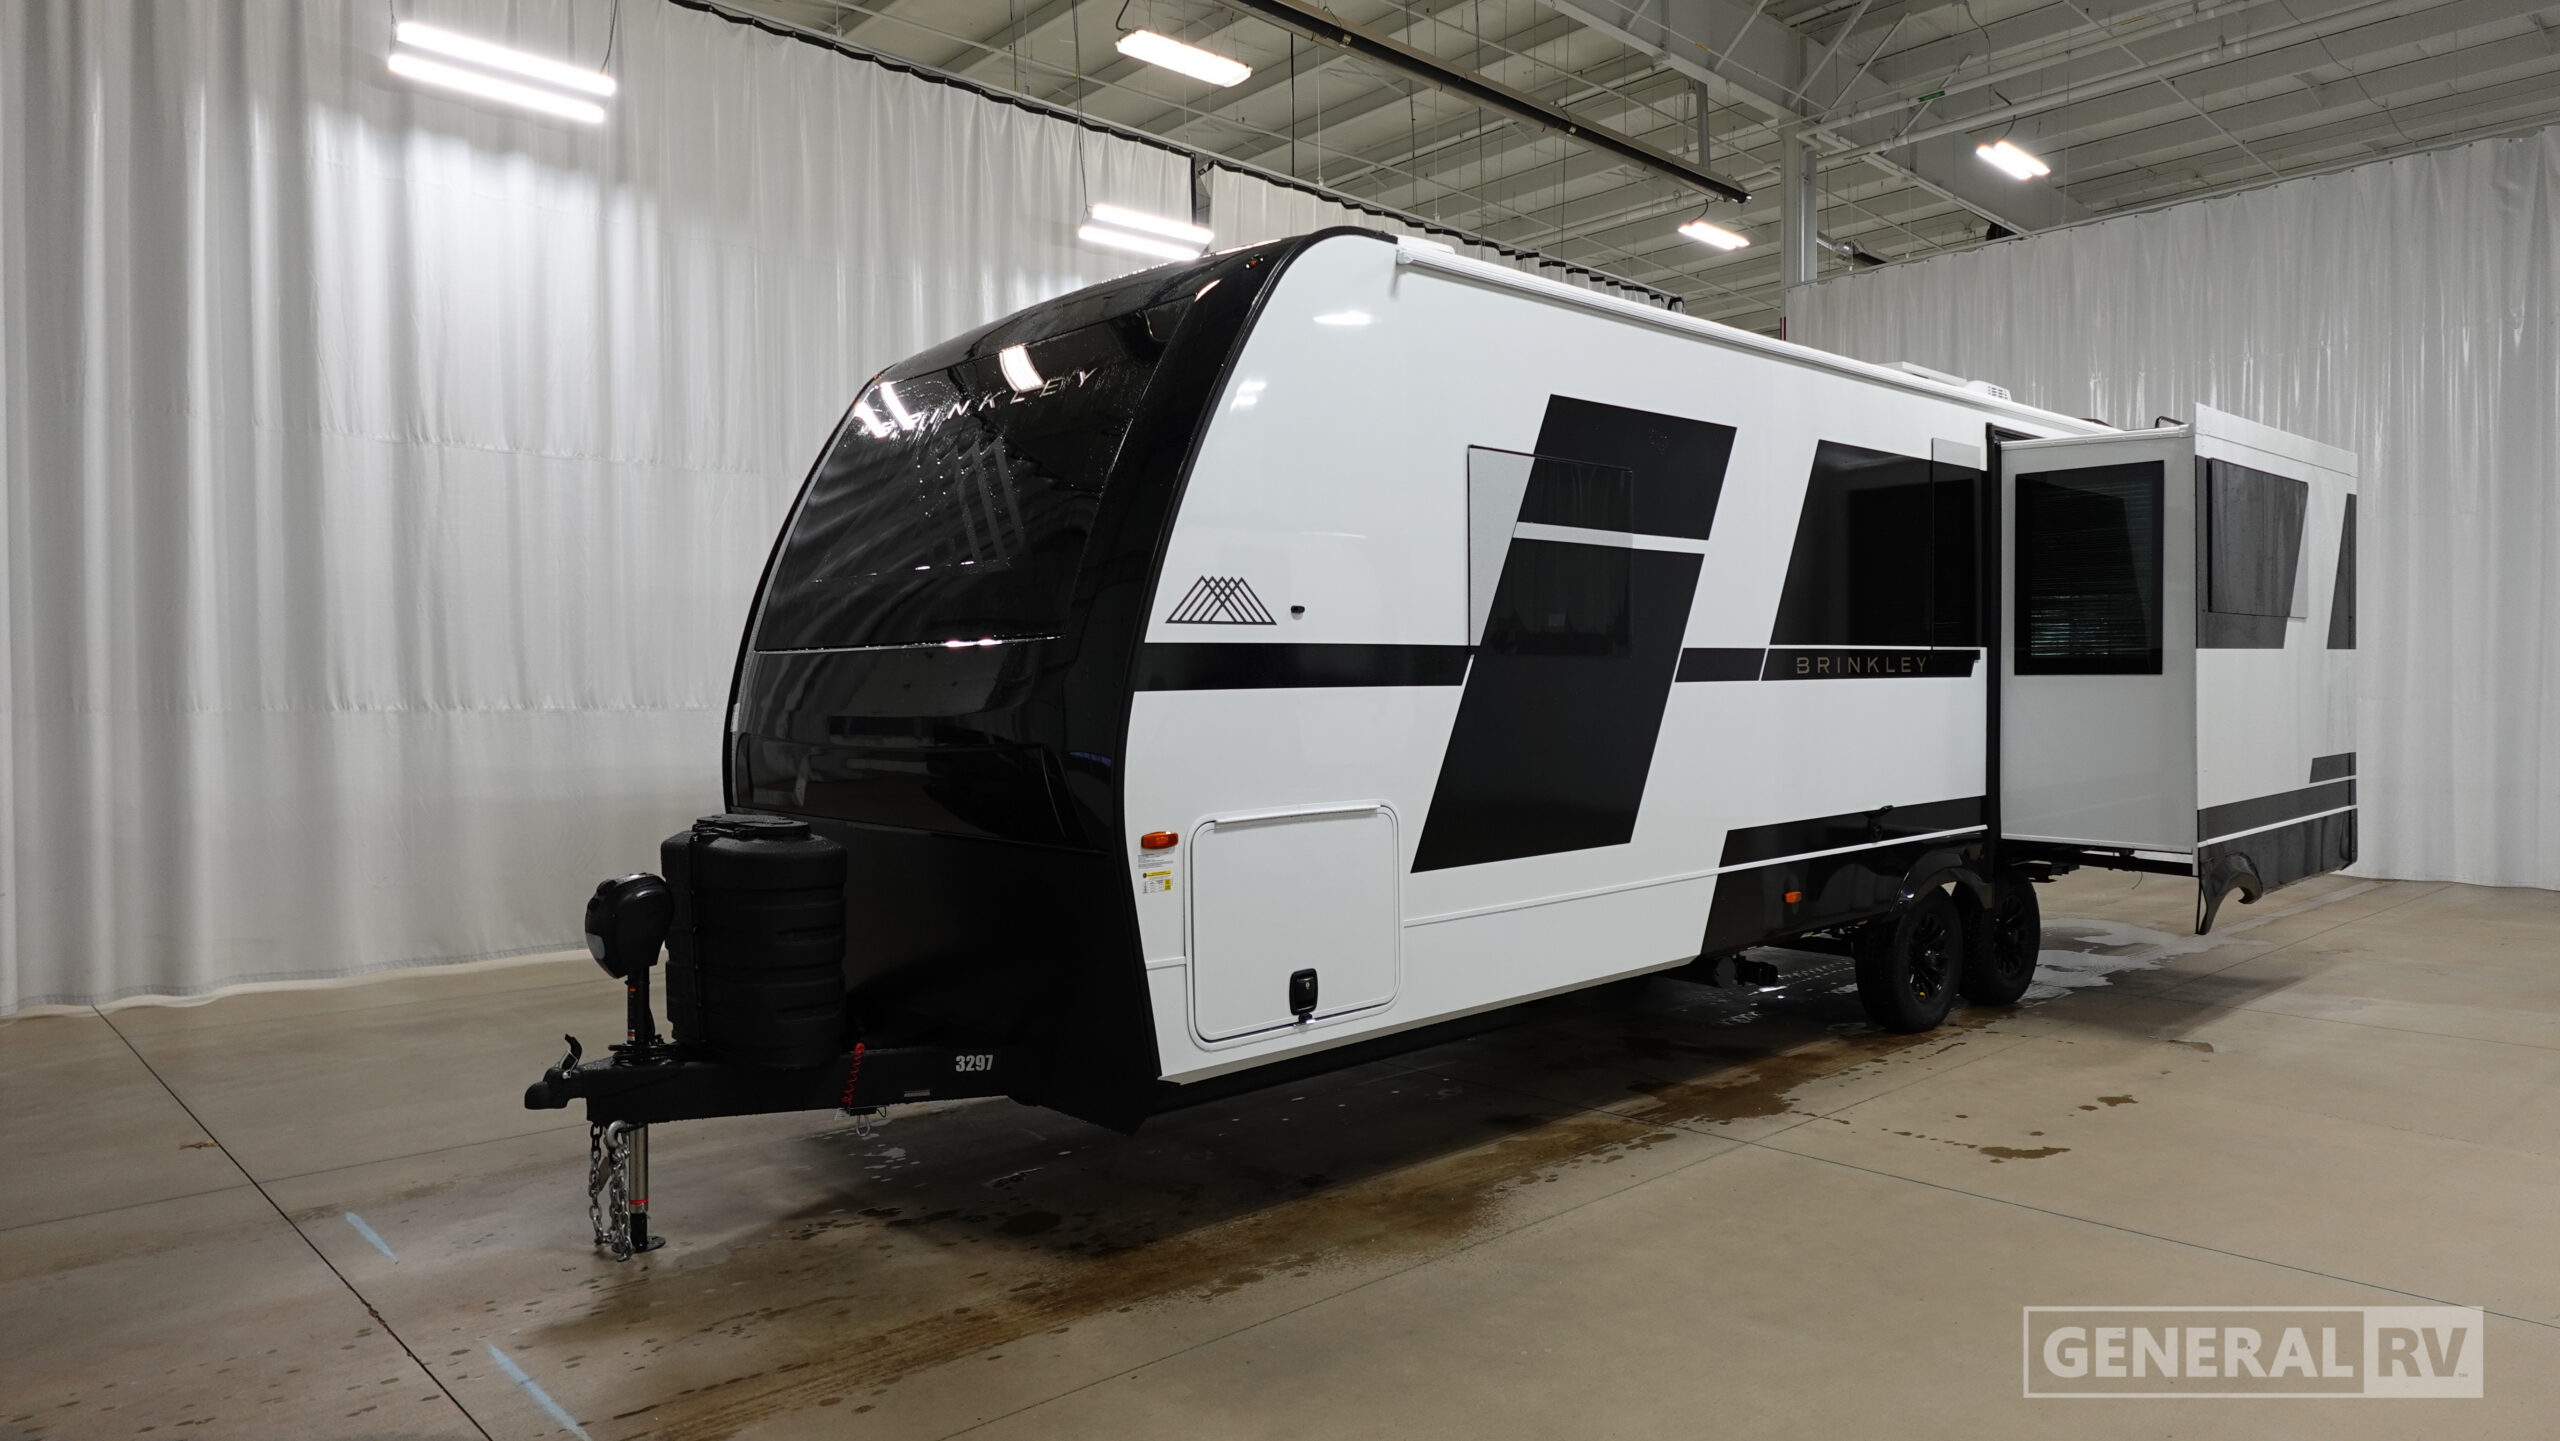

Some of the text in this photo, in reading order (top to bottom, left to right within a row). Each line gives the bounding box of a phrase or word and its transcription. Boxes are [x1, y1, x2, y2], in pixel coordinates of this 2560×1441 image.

[874, 367, 1098, 438] INKLEY
[1796, 656, 1927, 675] BRINKLEY
[955, 1054, 994, 1073] 3297
